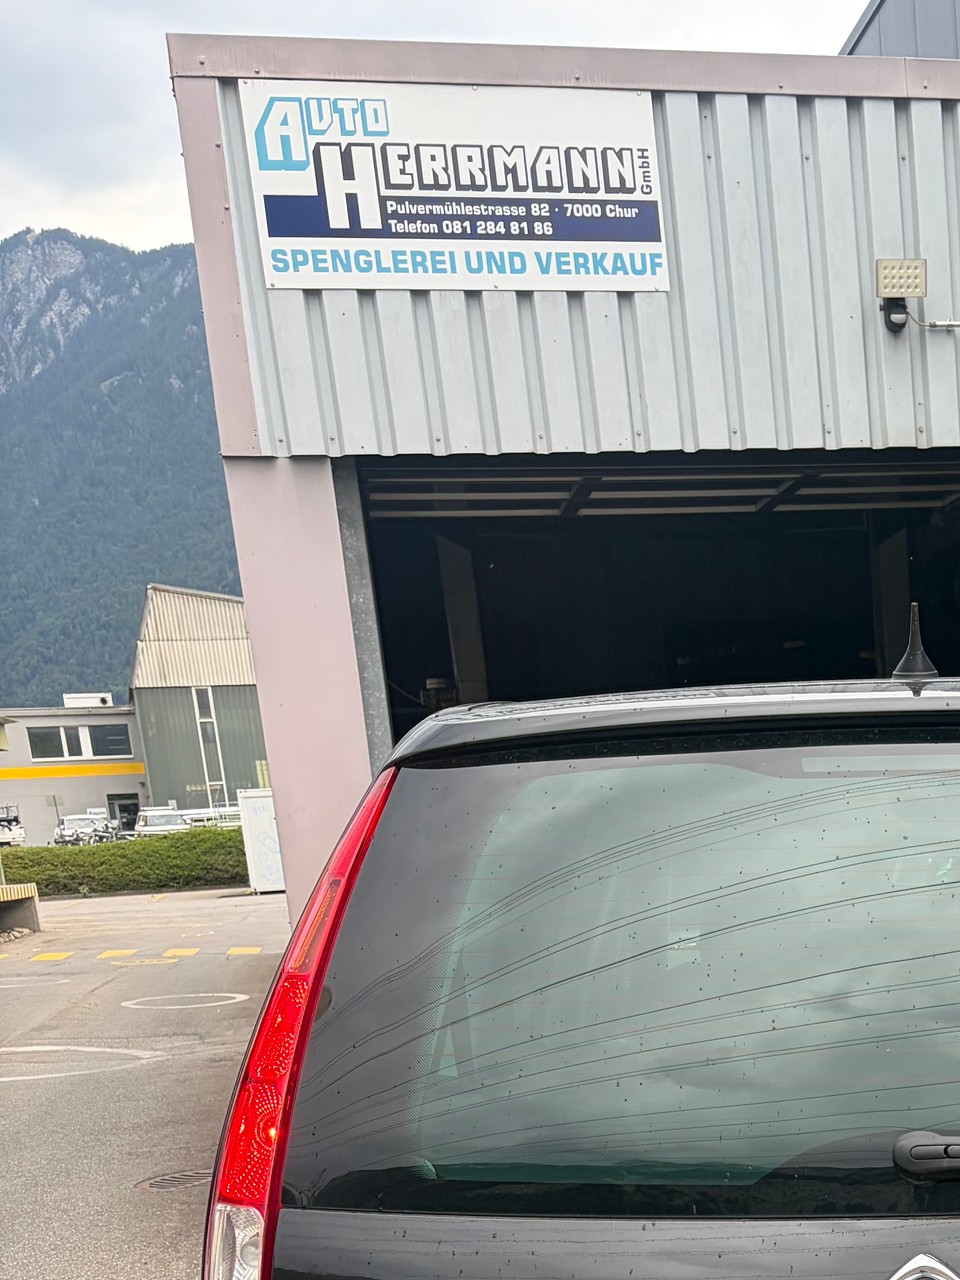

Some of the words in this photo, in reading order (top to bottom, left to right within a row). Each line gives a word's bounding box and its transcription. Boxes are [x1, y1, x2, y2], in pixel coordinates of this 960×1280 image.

[254, 97, 390, 171] AUTO
[312, 142, 637, 230] HERRMANN
[637, 148, 653, 195] GmbH
[386, 201, 527, 217] Pulvermühlestrasse
[531, 204, 550, 217] 82
[564, 204, 602, 217] 7000
[606, 204, 639, 218] Chur
[388, 220, 439, 234] Telefon
[442, 220, 471, 234] 081
[476, 221, 506, 235] 284
[510, 222, 530, 235] 81
[533, 222, 553, 236] 86
[270, 248, 457, 274] SPENGLEREI
[465, 250, 527, 275] UND
[534, 252, 664, 276] VERKAUF
